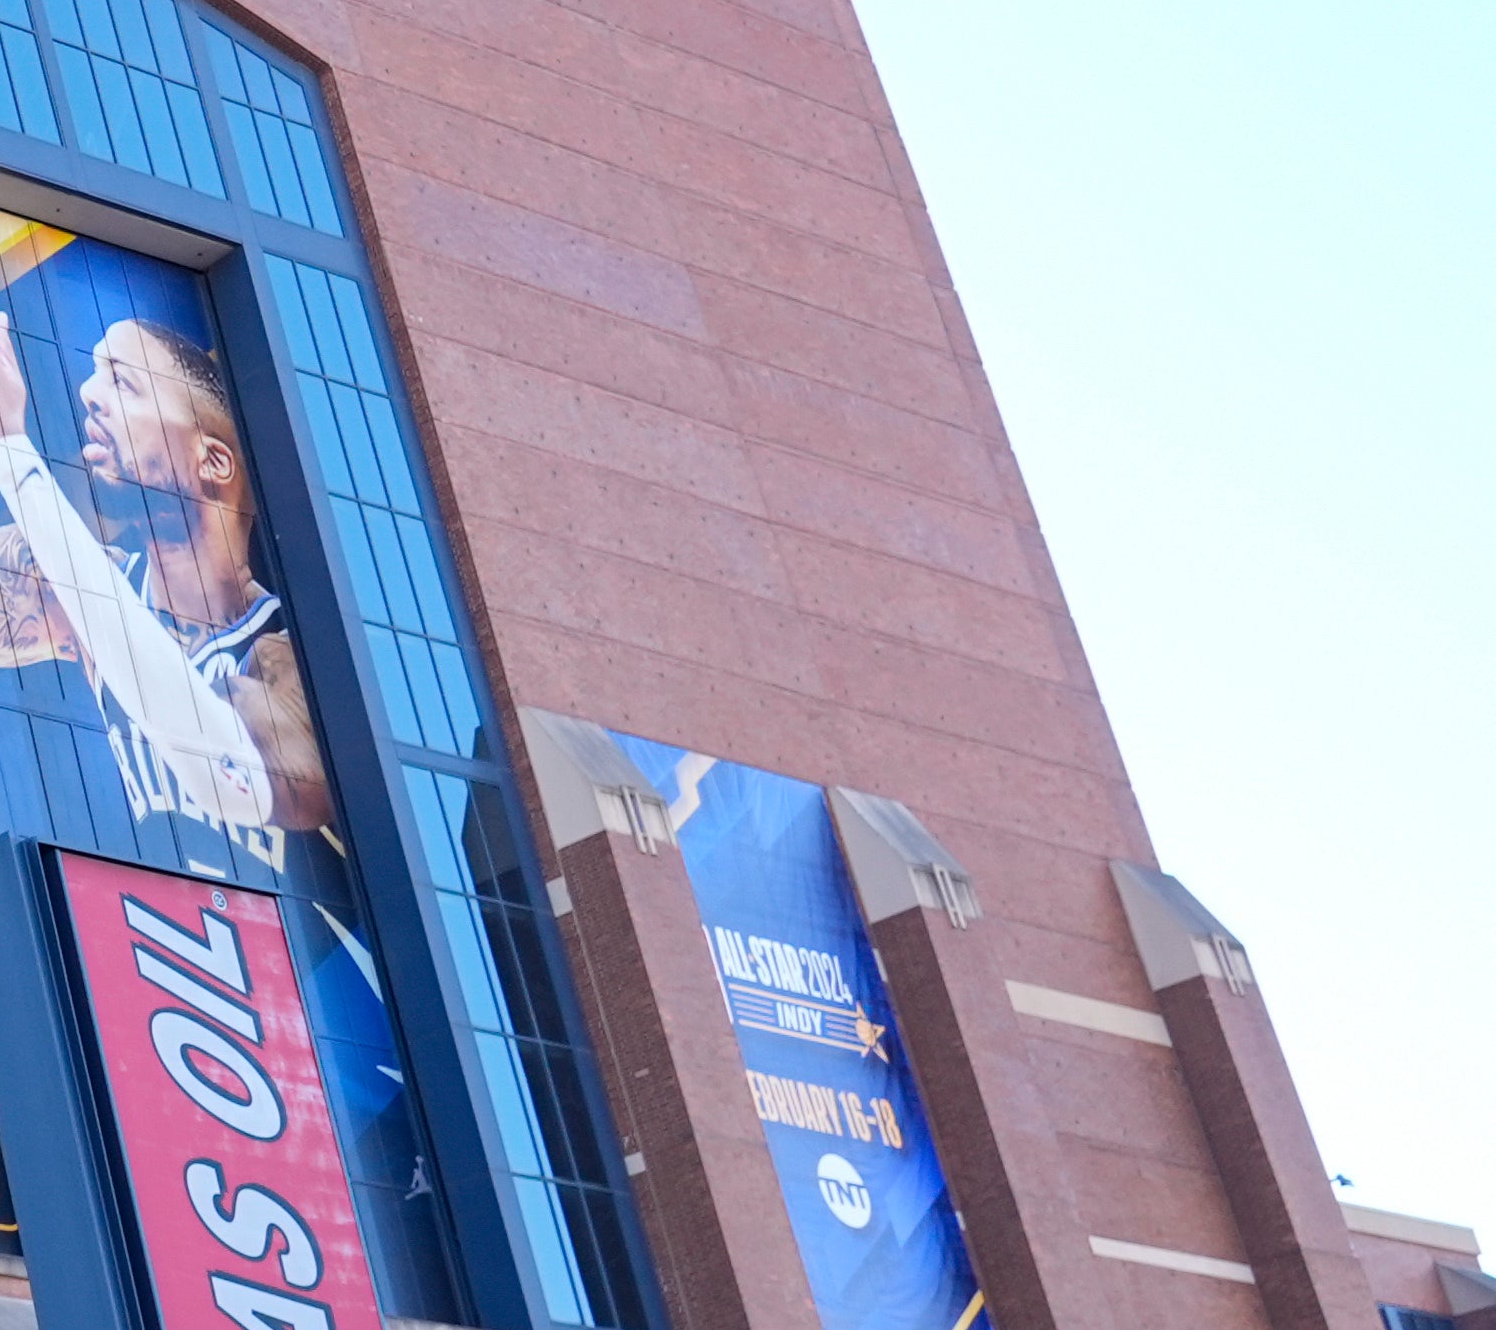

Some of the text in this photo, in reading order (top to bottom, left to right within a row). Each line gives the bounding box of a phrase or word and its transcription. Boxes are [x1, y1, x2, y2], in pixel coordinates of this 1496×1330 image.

[800, 948, 854, 1005] 2024
[119, 888, 287, 1142] OIL
[775, 1002, 823, 1036] INDY
[746, 1069, 903, 1150] EBRUARY 16-18
